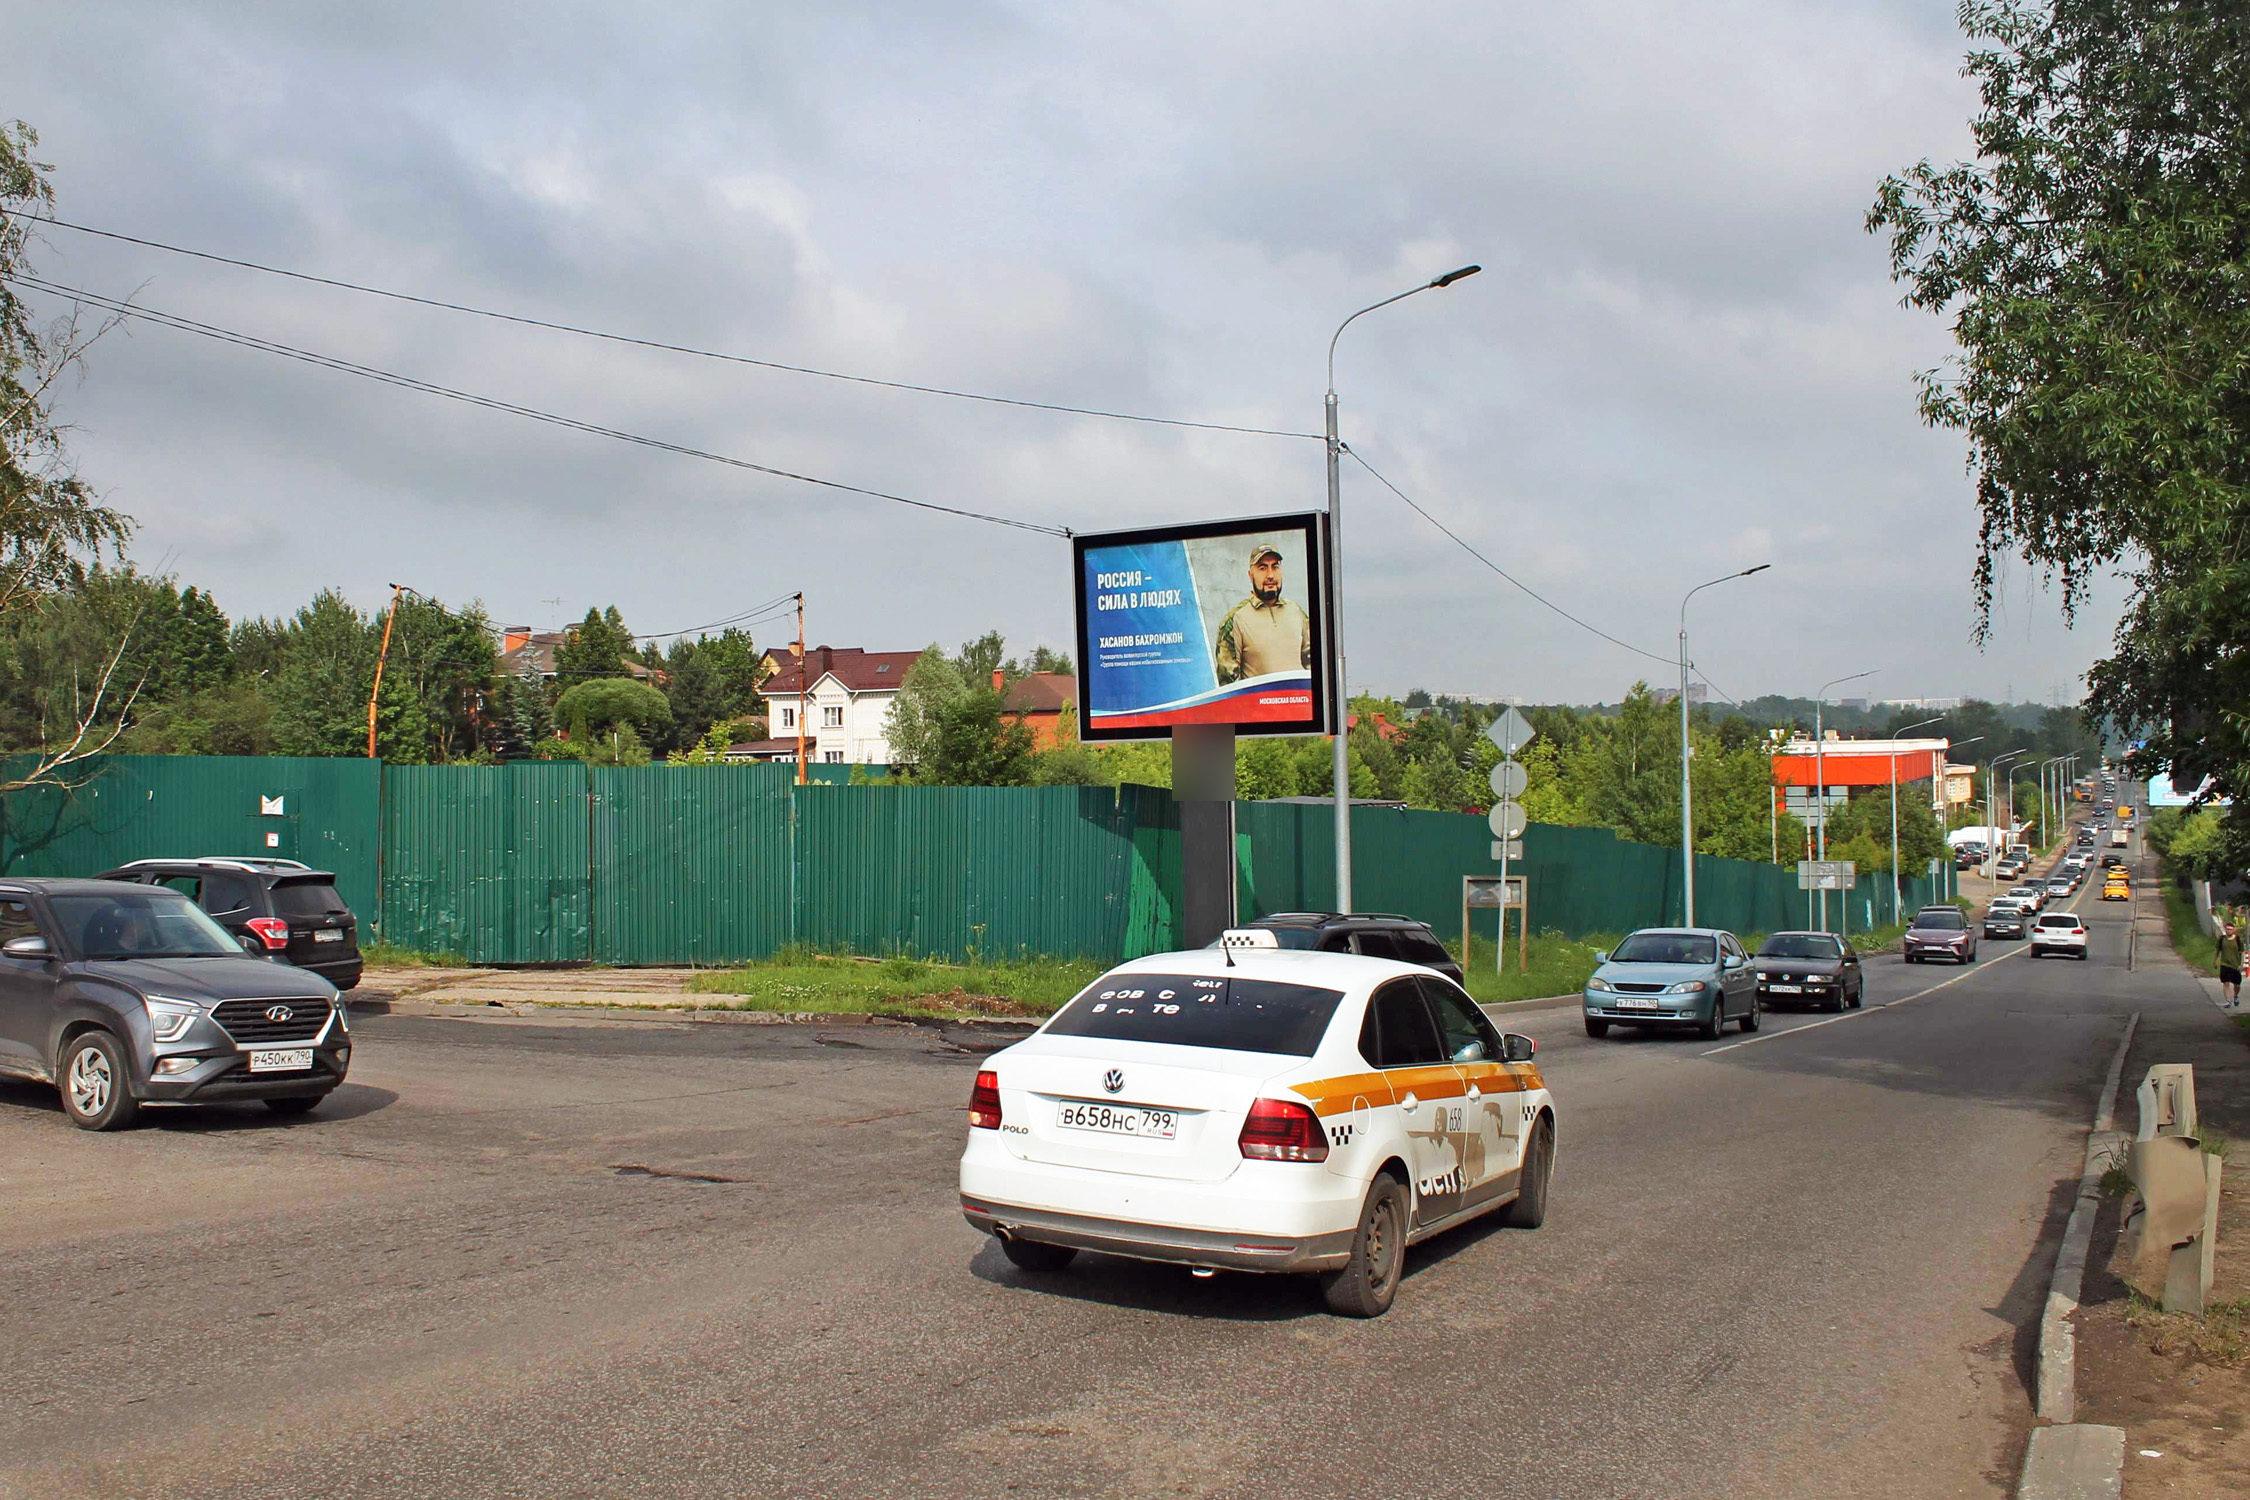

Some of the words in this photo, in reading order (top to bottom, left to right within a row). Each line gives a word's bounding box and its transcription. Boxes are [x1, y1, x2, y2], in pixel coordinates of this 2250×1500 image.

[1097, 570, 1142, 589] РОССИЯ
[1097, 593, 1129, 611] СИЛА
[1130, 593, 1138, 608] В
[1140, 589, 1182, 608] ЛЮДЯХ
[1100, 635, 1134, 648] ХАСАНОВ
[1135, 632, 1183, 646] БАХРОМЖОН
[1259, 696, 1289, 704] МОСКОВСКАЯ
[1289, 695, 1310, 703] ОБЛАСТЬ
[1063, 1105, 1136, 1131] В658НС
[1142, 1110, 1171, 1129] 799
[1449, 1107, 1463, 1132] 658
[1002, 1124, 1029, 1135] POLO
[1146, 1128, 1162, 1136] RUS
